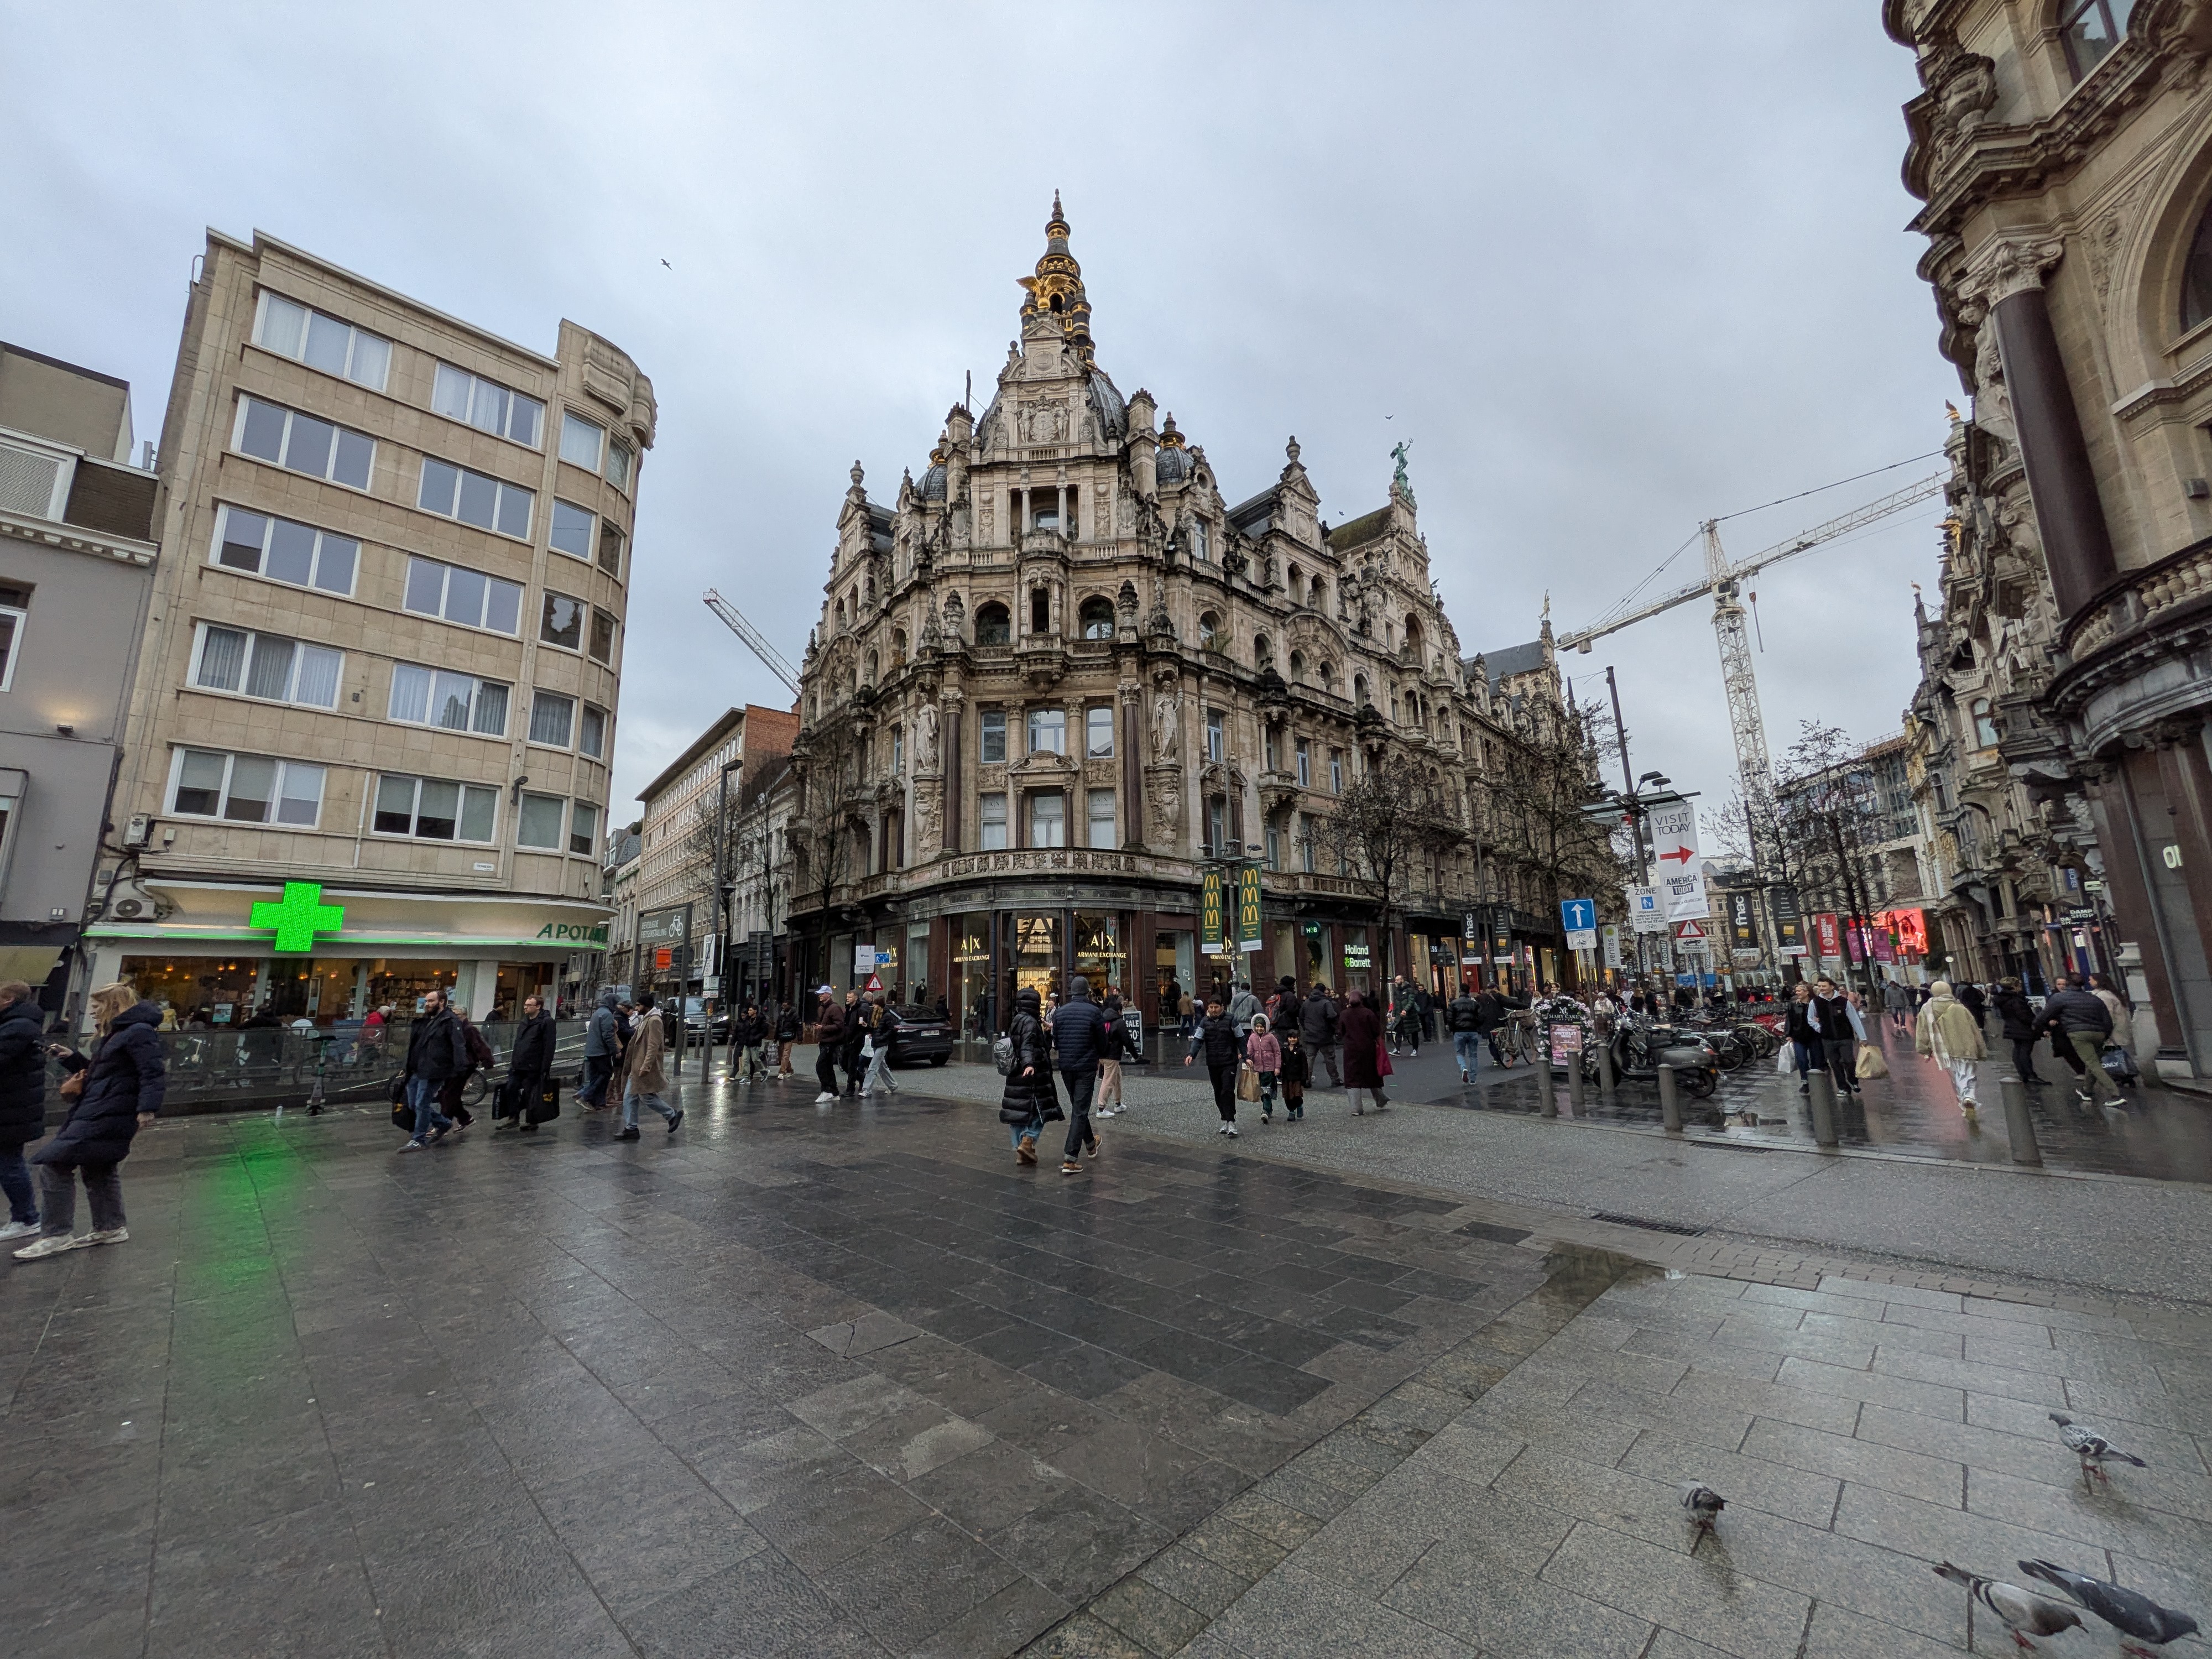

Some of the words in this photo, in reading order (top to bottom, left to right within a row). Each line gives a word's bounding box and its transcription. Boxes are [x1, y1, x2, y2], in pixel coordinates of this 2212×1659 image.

[1655, 812, 1689, 826] VISIT
[1655, 822, 1692, 836] TODAY
[1666, 874, 1698, 886] AMERICA
[1635, 887, 1657, 895] ZONE
[1673, 884, 1693, 895] TODAY
[1735, 895, 1748, 926] fnac
[1465, 913, 1474, 938] fnac
[1344, 944, 1369, 955] Holland
[1660, 940, 1669, 965] wondr
[1349, 957, 1371, 968] Barrett
